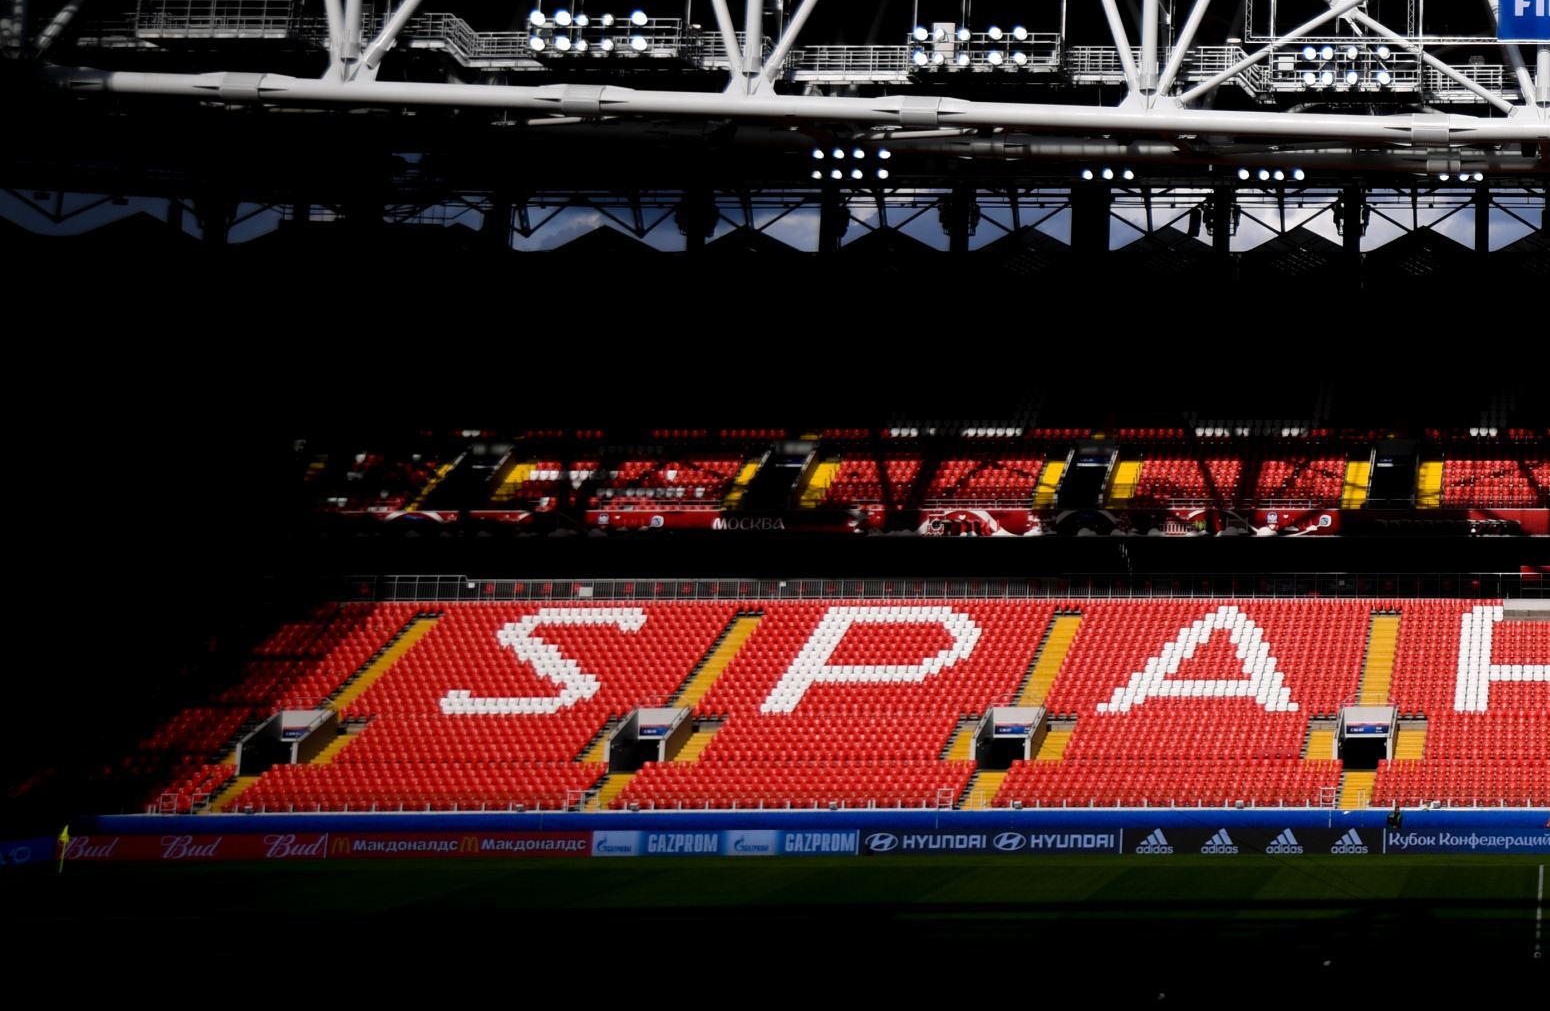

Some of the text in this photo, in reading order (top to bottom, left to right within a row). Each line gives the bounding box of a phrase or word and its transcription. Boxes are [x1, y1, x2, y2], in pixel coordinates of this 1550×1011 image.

[711, 516, 786, 531] МОСКВА
[160, 834, 223, 860] Bud
[264, 833, 327, 859] Bud
[352, 836, 458, 853] Макдоналдс
[480, 835, 587, 852] Макдоналдс
[647, 833, 718, 853] GAZPROM
[784, 832, 856, 852] GAZPROM
[902, 834, 987, 849] HYUNDAI
[1030, 834, 1115, 849] HYUNDAI
[1388, 832, 1436, 849] Кубок
[1136, 845, 1174, 854] adidas
[1201, 845, 1239, 854] adidas
[1266, 845, 1303, 854] adidas
[1331, 845, 1368, 854] adidas
